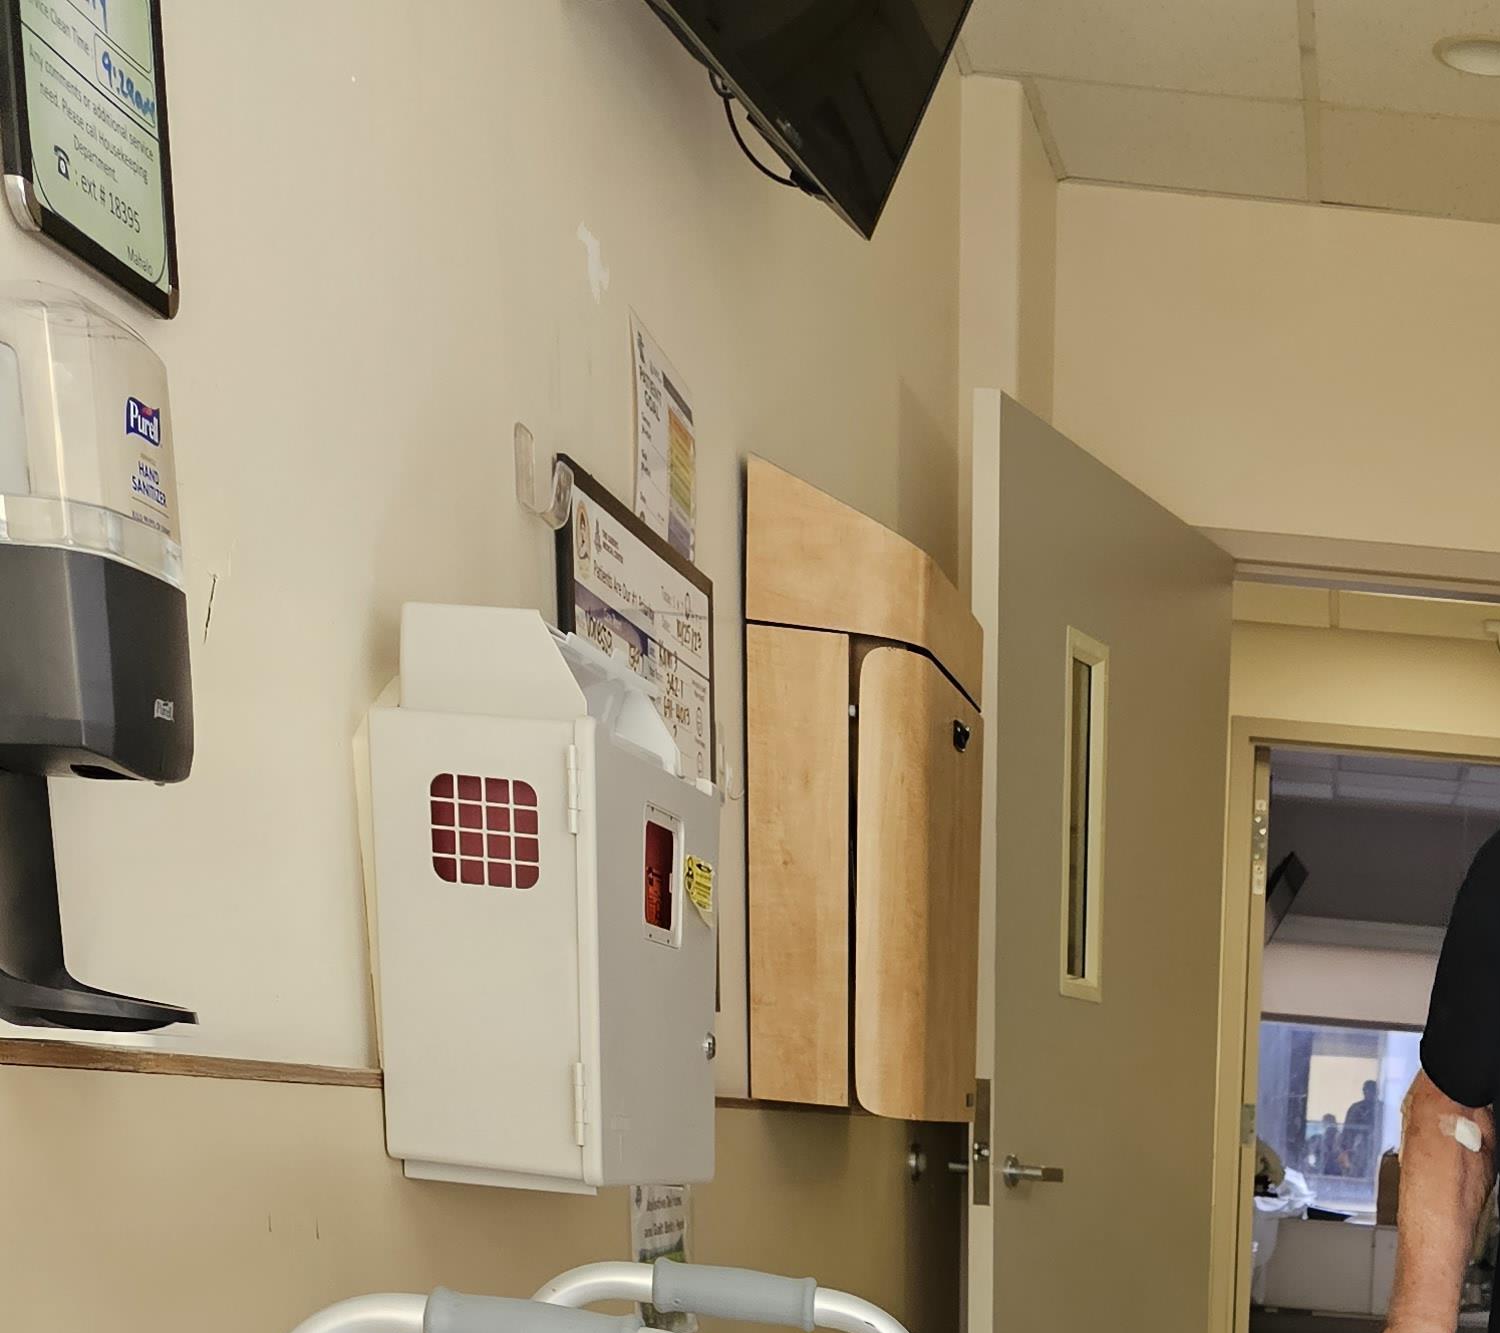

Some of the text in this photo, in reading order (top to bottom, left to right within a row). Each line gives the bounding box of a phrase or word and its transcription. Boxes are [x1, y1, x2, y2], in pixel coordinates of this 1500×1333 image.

[81, 175, 98, 201] ext
[108, 192, 141, 233] 18395
[129, 400, 158, 443] Purell
[138, 460, 160, 485] HAND
[131, 476, 167, 507] SANITIZER
